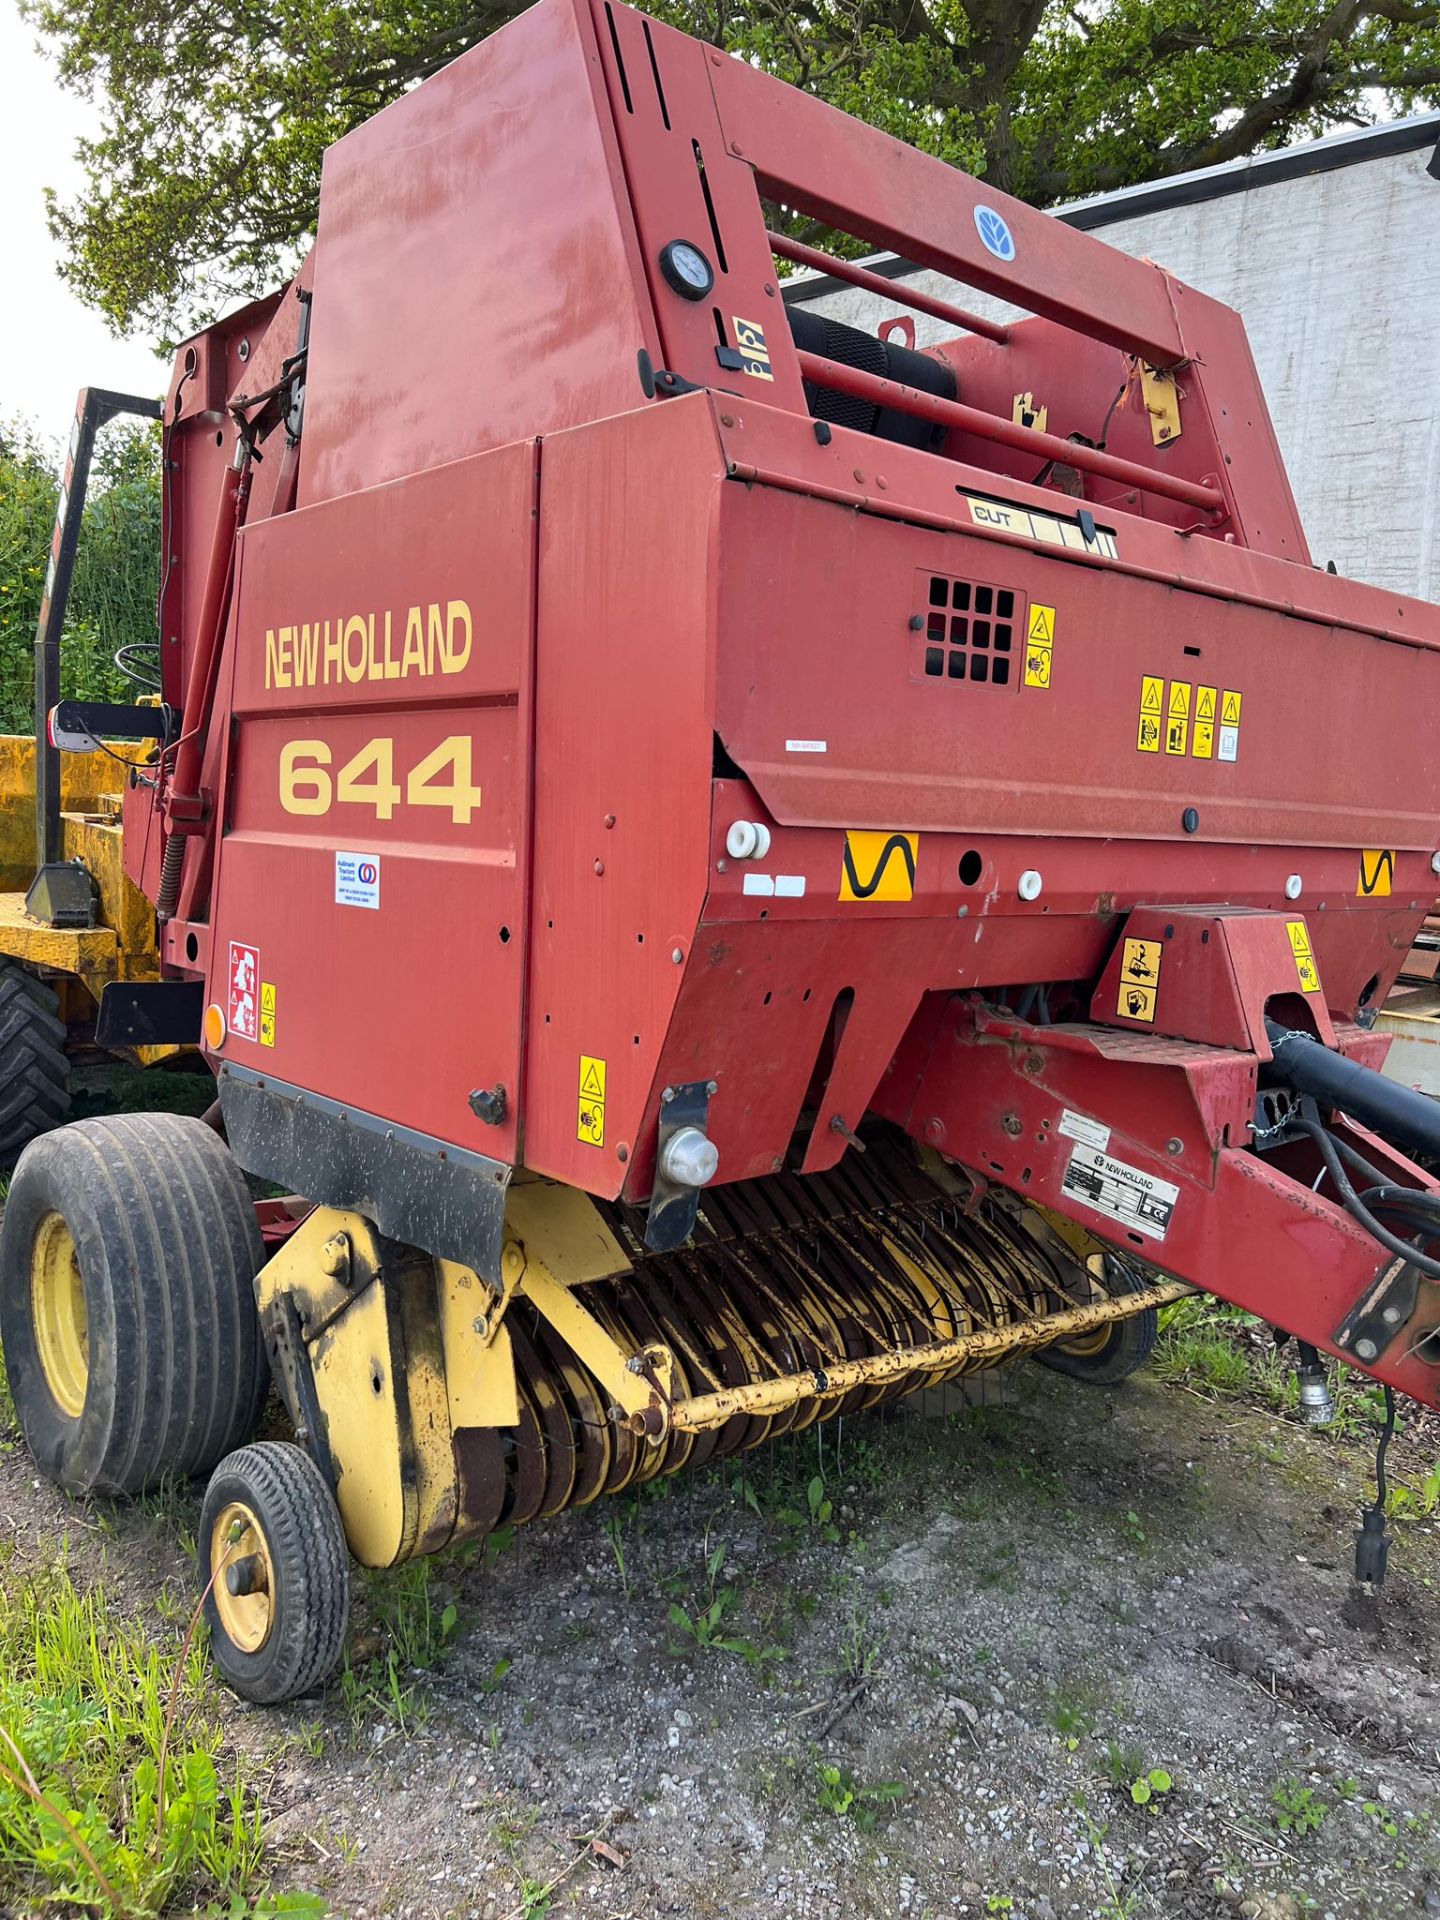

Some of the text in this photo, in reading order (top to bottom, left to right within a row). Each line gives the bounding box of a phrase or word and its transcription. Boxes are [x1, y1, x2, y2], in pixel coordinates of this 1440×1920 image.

[974, 506, 1011, 526] CUT
[265, 599, 472, 689] NEW HOLLAND
[279, 735, 481, 824] 644
[1105, 1163, 1121, 1176] NEW
[1120, 1170, 1154, 1190] HOLLAND
